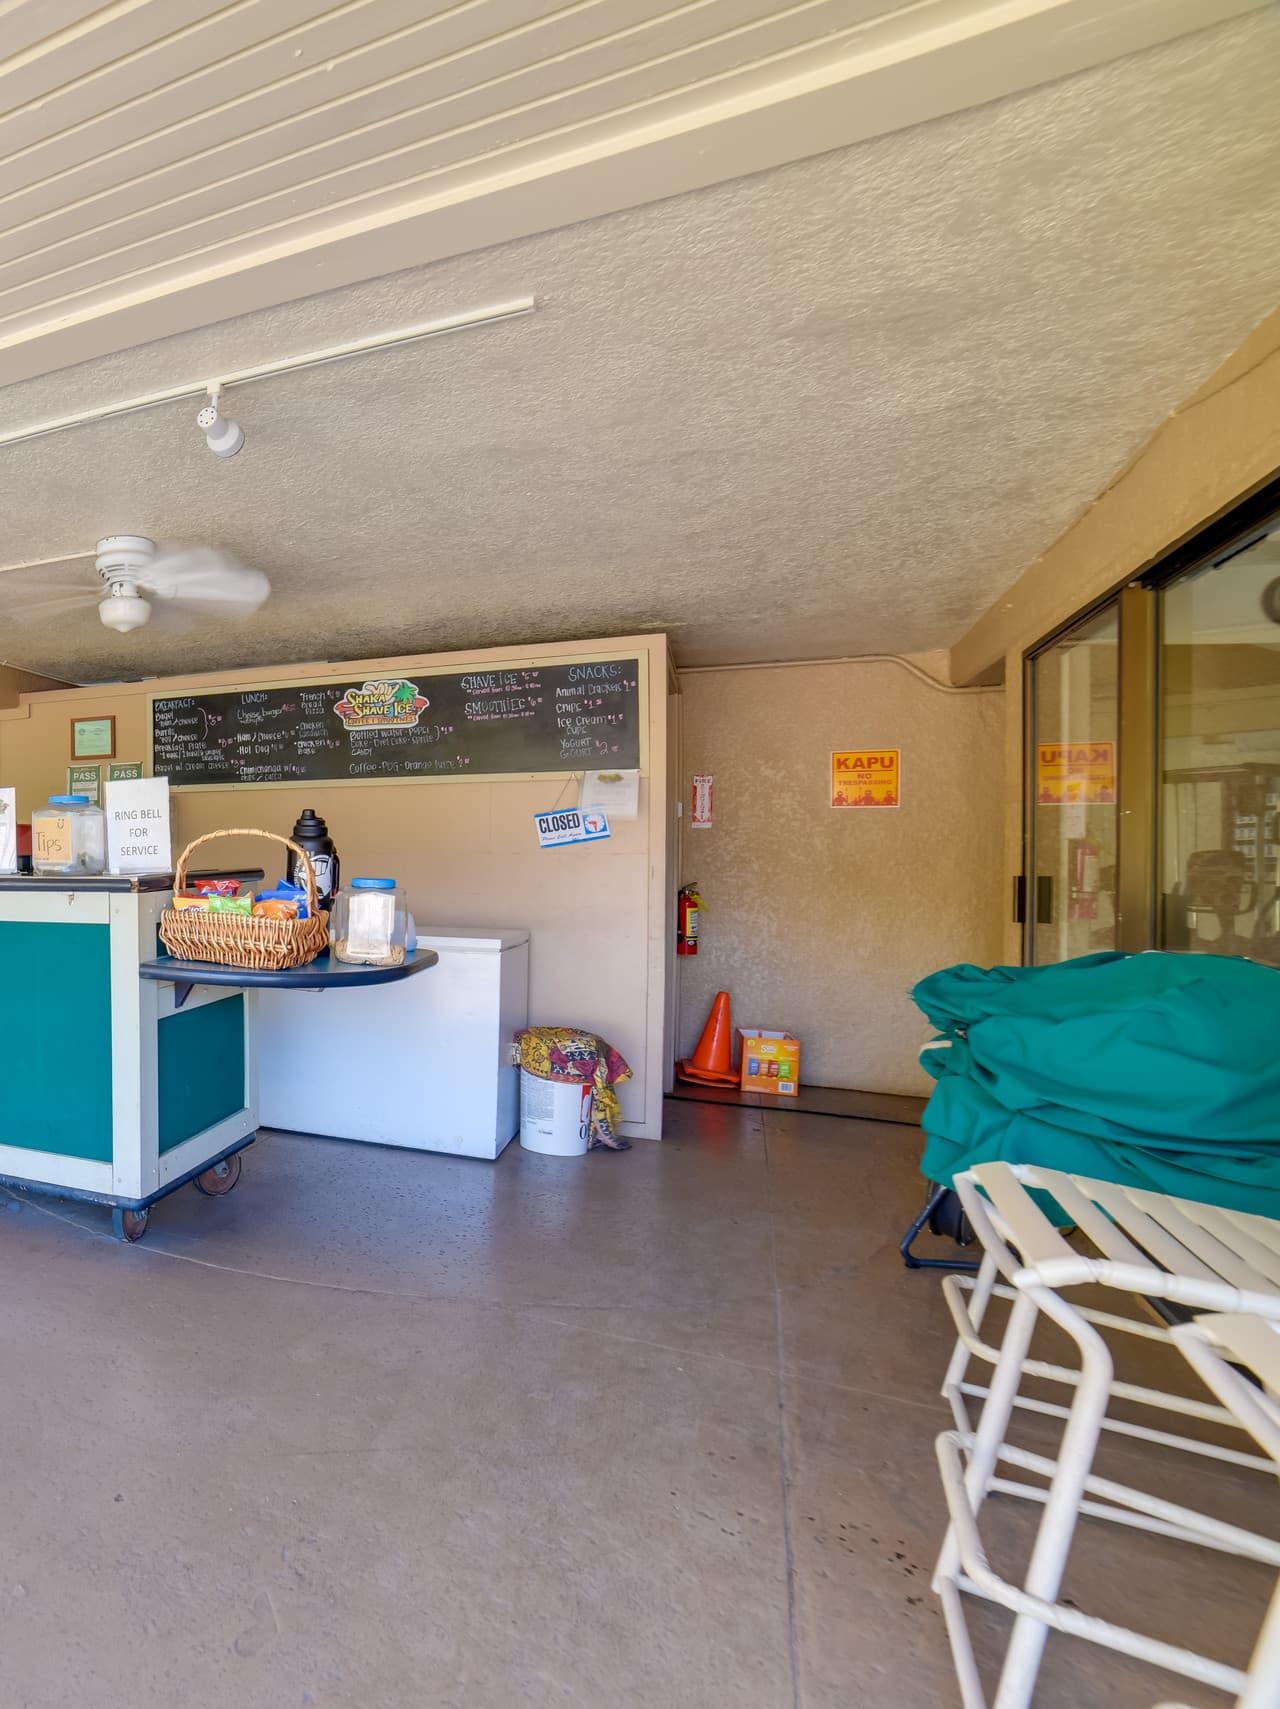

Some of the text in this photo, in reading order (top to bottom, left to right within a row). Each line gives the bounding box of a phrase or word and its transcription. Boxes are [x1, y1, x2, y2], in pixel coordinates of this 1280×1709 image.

[499, 671, 518, 685] ICE
[555, 684, 585, 697] Animal
[588, 682, 622, 695] Crackers
[347, 692, 386, 706] SHAKA
[354, 702, 413, 718] SHAVE ICE
[557, 715, 607, 728] Ice Cream
[349, 763, 376, 774] Coffee
[836, 756, 895, 769] KAPU
[73, 772, 96, 780] PASS
[114, 769, 138, 778] PASS
[114, 808, 162, 821] RING BELL
[538, 812, 581, 834] CLOSED
[129, 827, 148, 838] FOR
[35, 831, 62, 856] Tips
[120, 845, 159, 856] SERVICE
